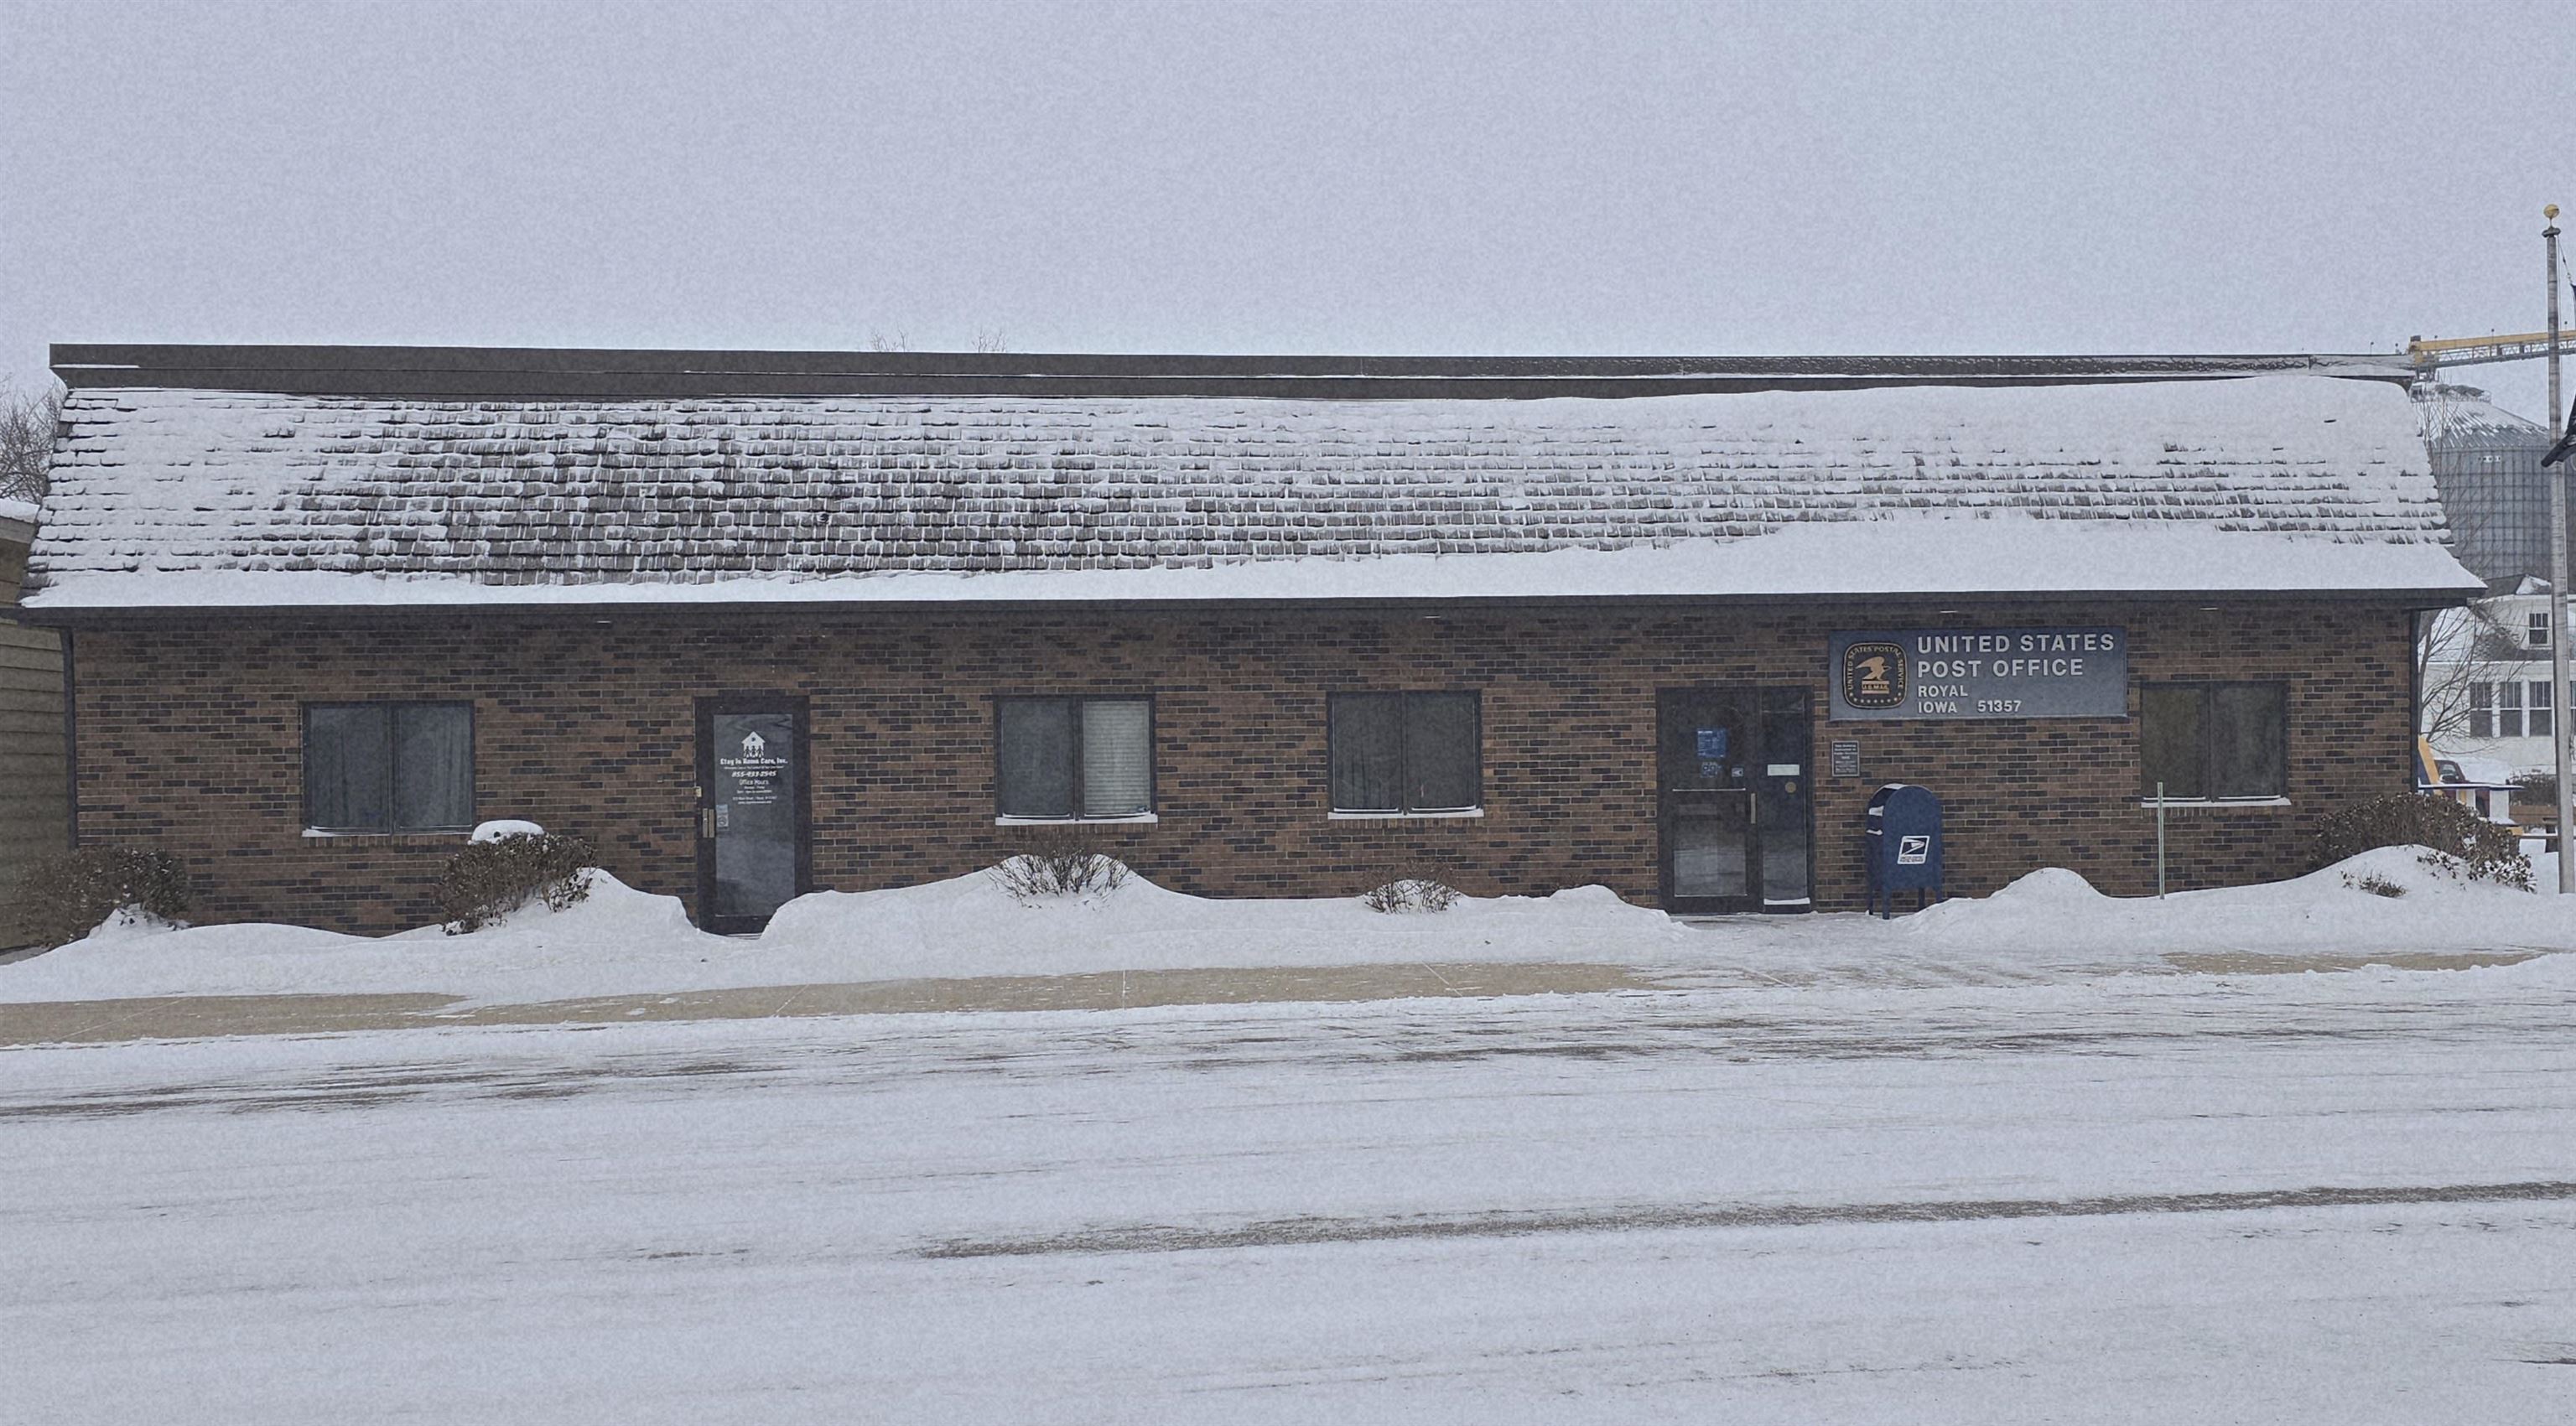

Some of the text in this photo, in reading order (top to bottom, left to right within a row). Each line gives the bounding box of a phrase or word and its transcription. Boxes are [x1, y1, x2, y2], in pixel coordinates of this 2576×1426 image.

[1918, 634, 2114, 654] UNITED STATES
[1848, 646, 1872, 659] STATES
[1873, 646, 1902, 658] POSTAL
[1918, 658, 2083, 677] POST OFFICE
[1918, 685, 1968, 697] ROYAL
[1919, 700, 2022, 713] IOWA 51357
[720, 758, 735, 766] Stay
